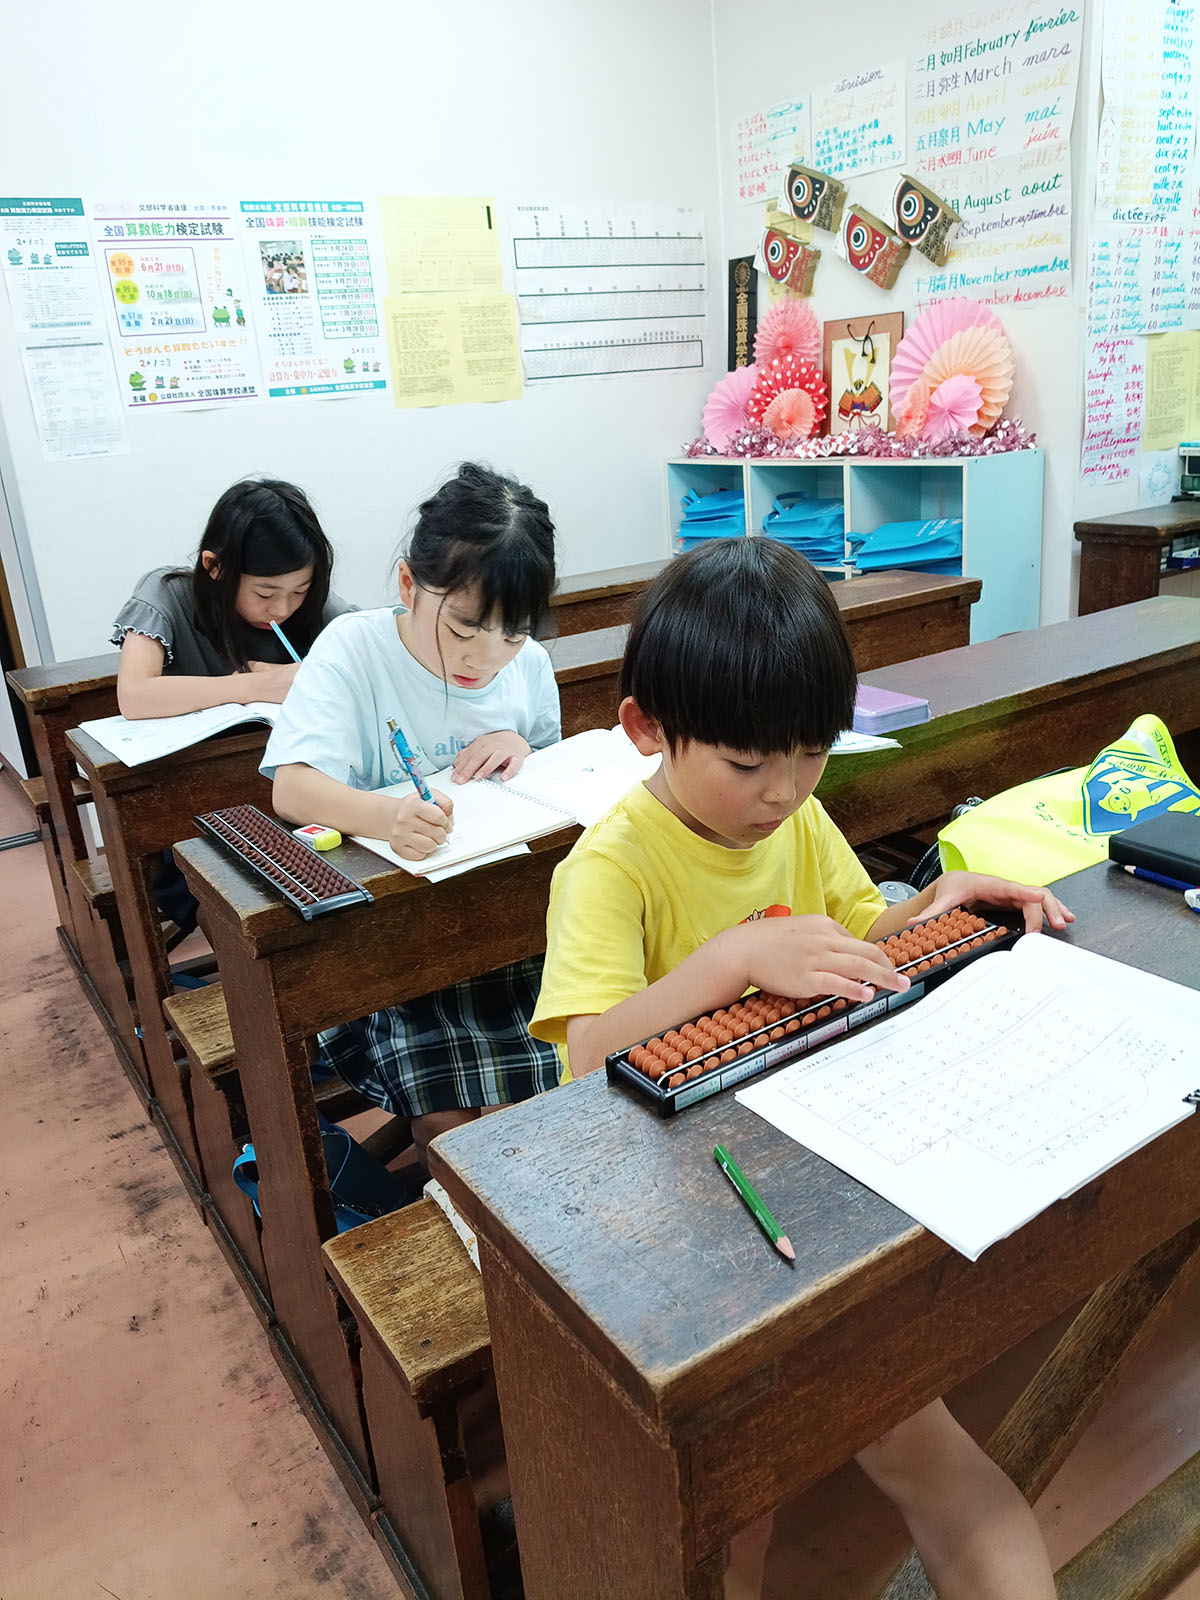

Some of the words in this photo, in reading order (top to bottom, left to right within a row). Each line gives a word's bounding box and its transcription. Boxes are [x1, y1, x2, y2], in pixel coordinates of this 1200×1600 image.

[964, 29, 1020, 60] February
[964, 56, 1012, 86] March
[1161, 90, 1172, 100] six
[1159, 105, 1176, 120] sept
[967, 116, 1006, 138] May
[963, 146, 997, 164] June
[1156, 148, 1169, 159] dix
[963, 188, 1011, 214] August
[1112, 207, 1143, 221] dictée
[960, 213, 1017, 238] September
[959, 265, 1014, 288] November
[1112, 294, 1121, 304] 12
[1148, 321, 1158, 330] 60
